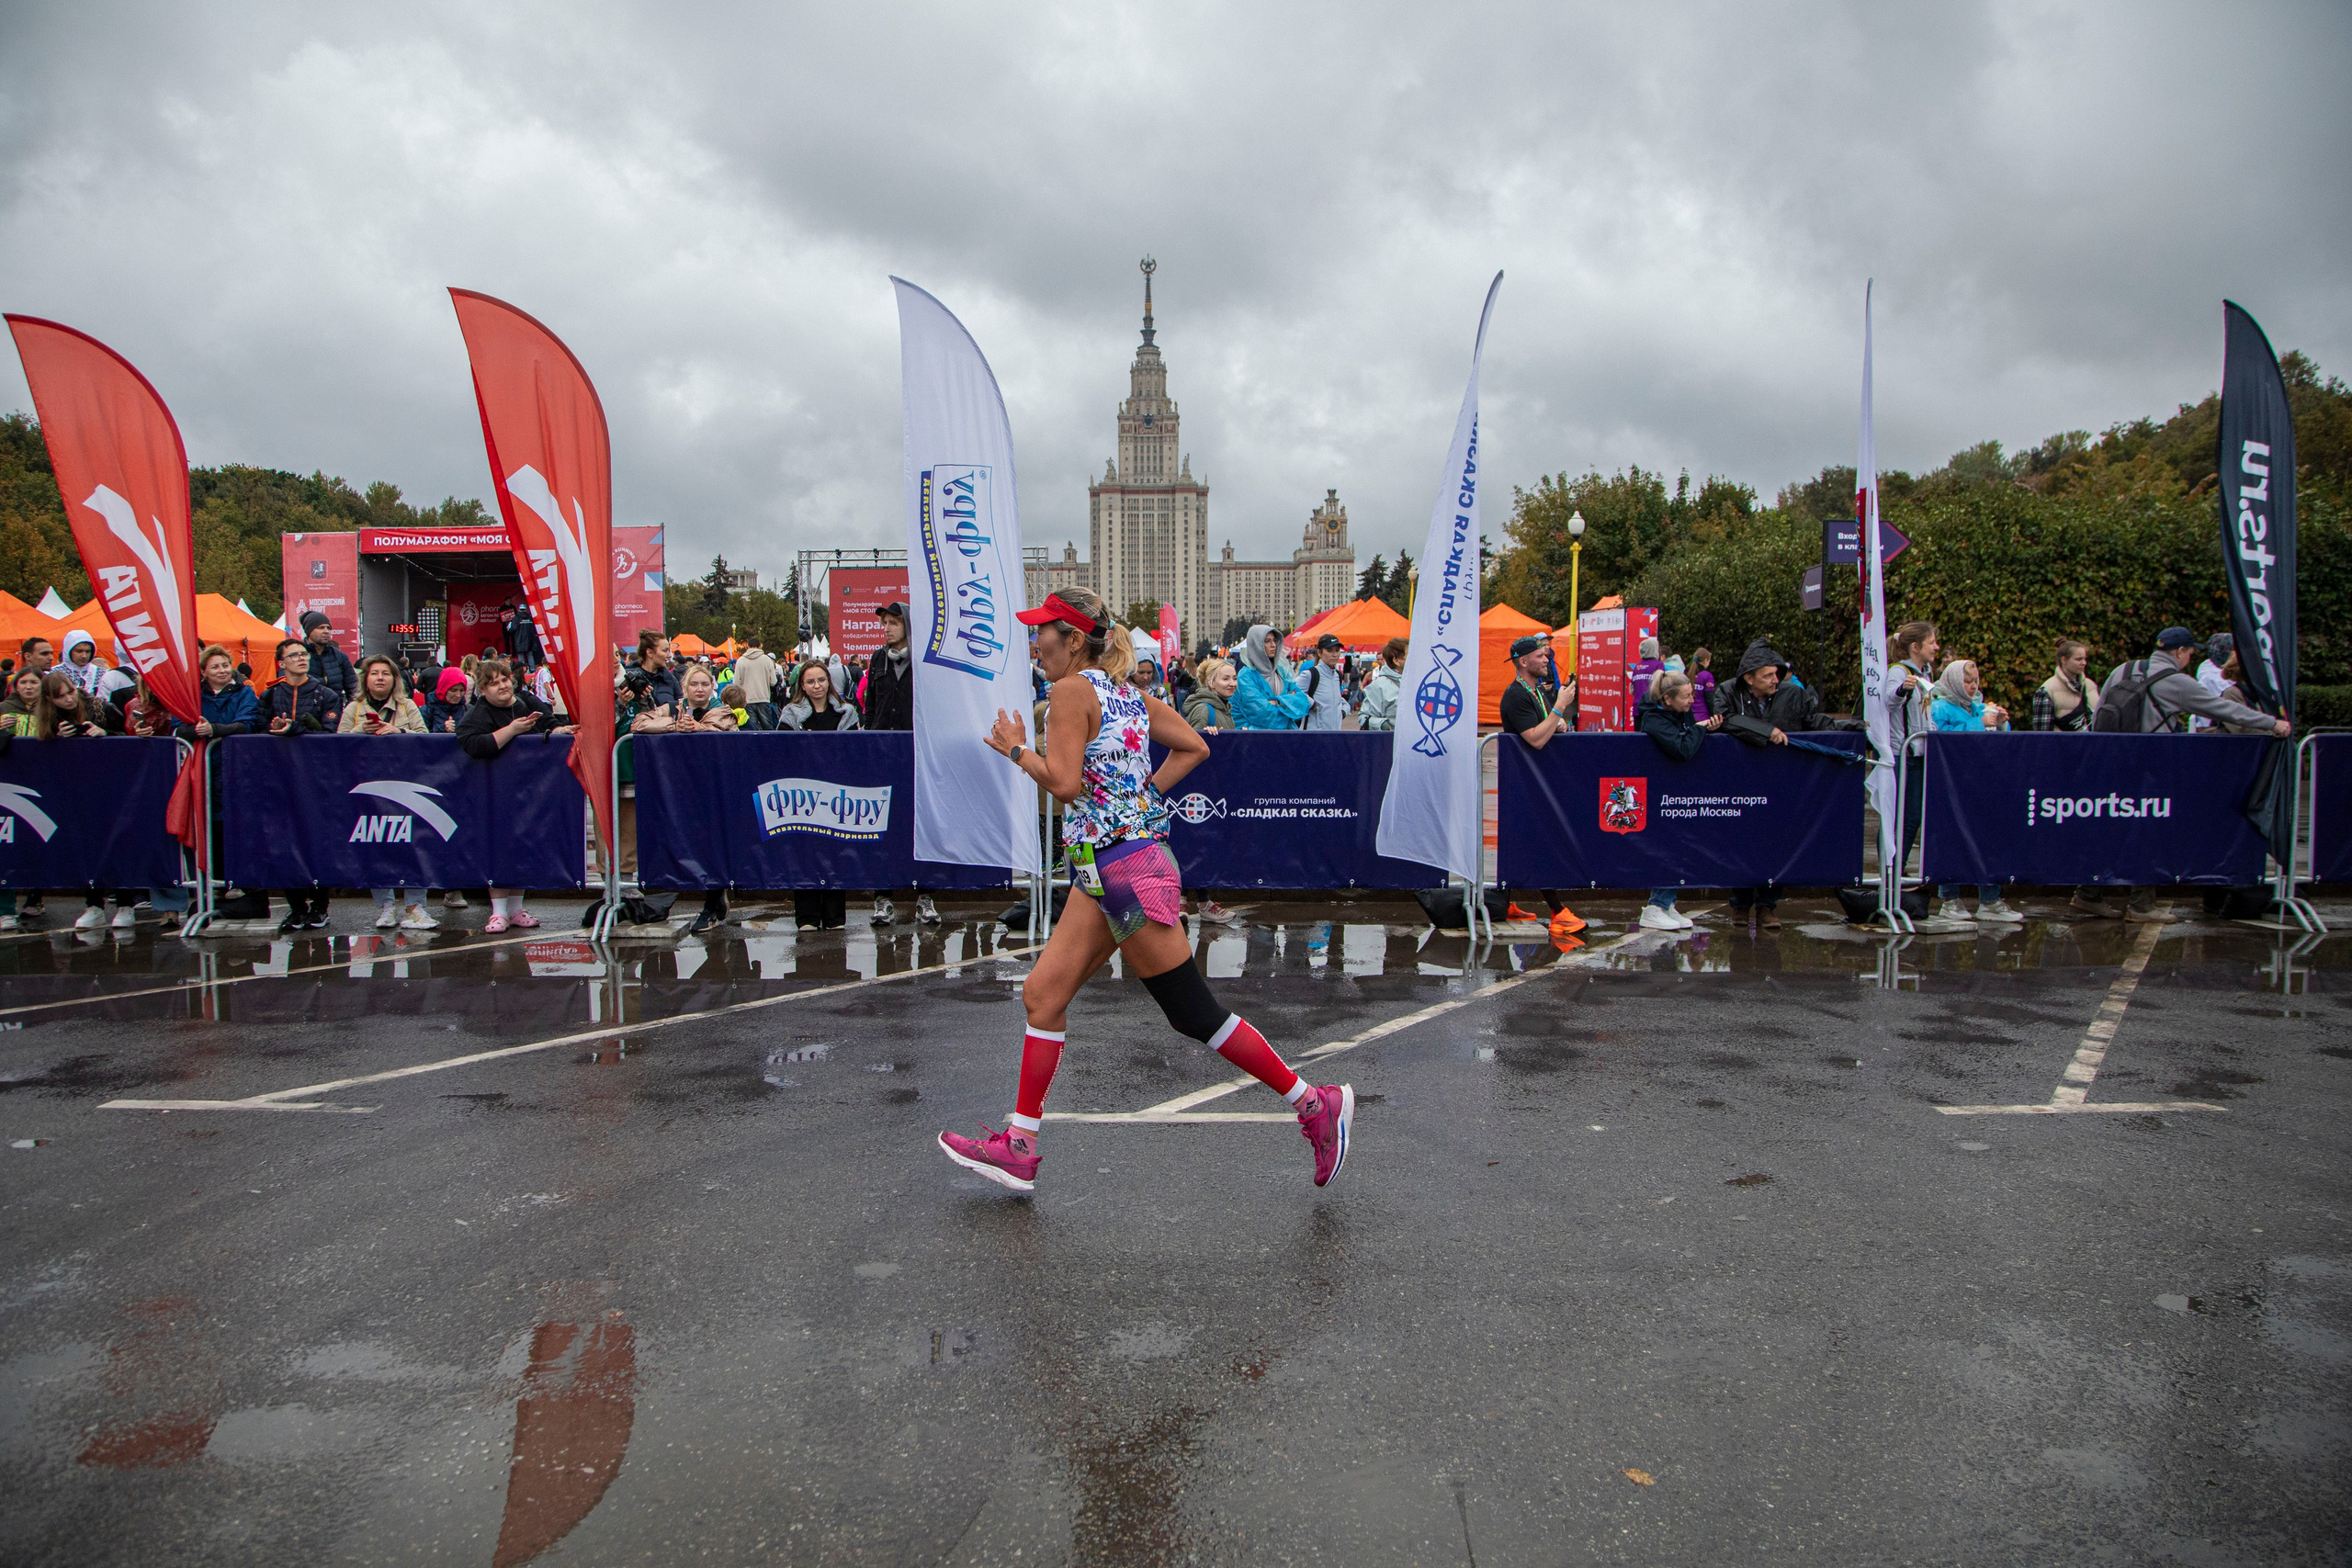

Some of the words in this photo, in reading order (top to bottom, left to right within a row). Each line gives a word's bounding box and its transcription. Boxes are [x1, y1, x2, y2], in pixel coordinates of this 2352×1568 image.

[374, 536, 468, 547] ПОЛУМАРАФОН
[469, 535, 503, 545] «МОЯ
[309, 596, 345, 605] МОСКОВСКИЙ
[766, 783, 888, 826] фру-фру
[1254, 797, 1287, 806] группа
[1288, 796, 1336, 806] компаний
[1660, 795, 1729, 807] Департамент
[1731, 796, 1768, 807] спорта
[1230, 807, 1297, 819] «СЛАДКАЯ
[1300, 807, 1359, 818] СКАЗКА»
[1660, 808, 1698, 819] города
[1700, 807, 1741, 817] Москвы
[2040, 792, 2171, 824] sports.ru
[348, 815, 413, 843] ANTA
[768, 825, 831, 836] жевательный
[833, 830, 879, 840] мармелад
